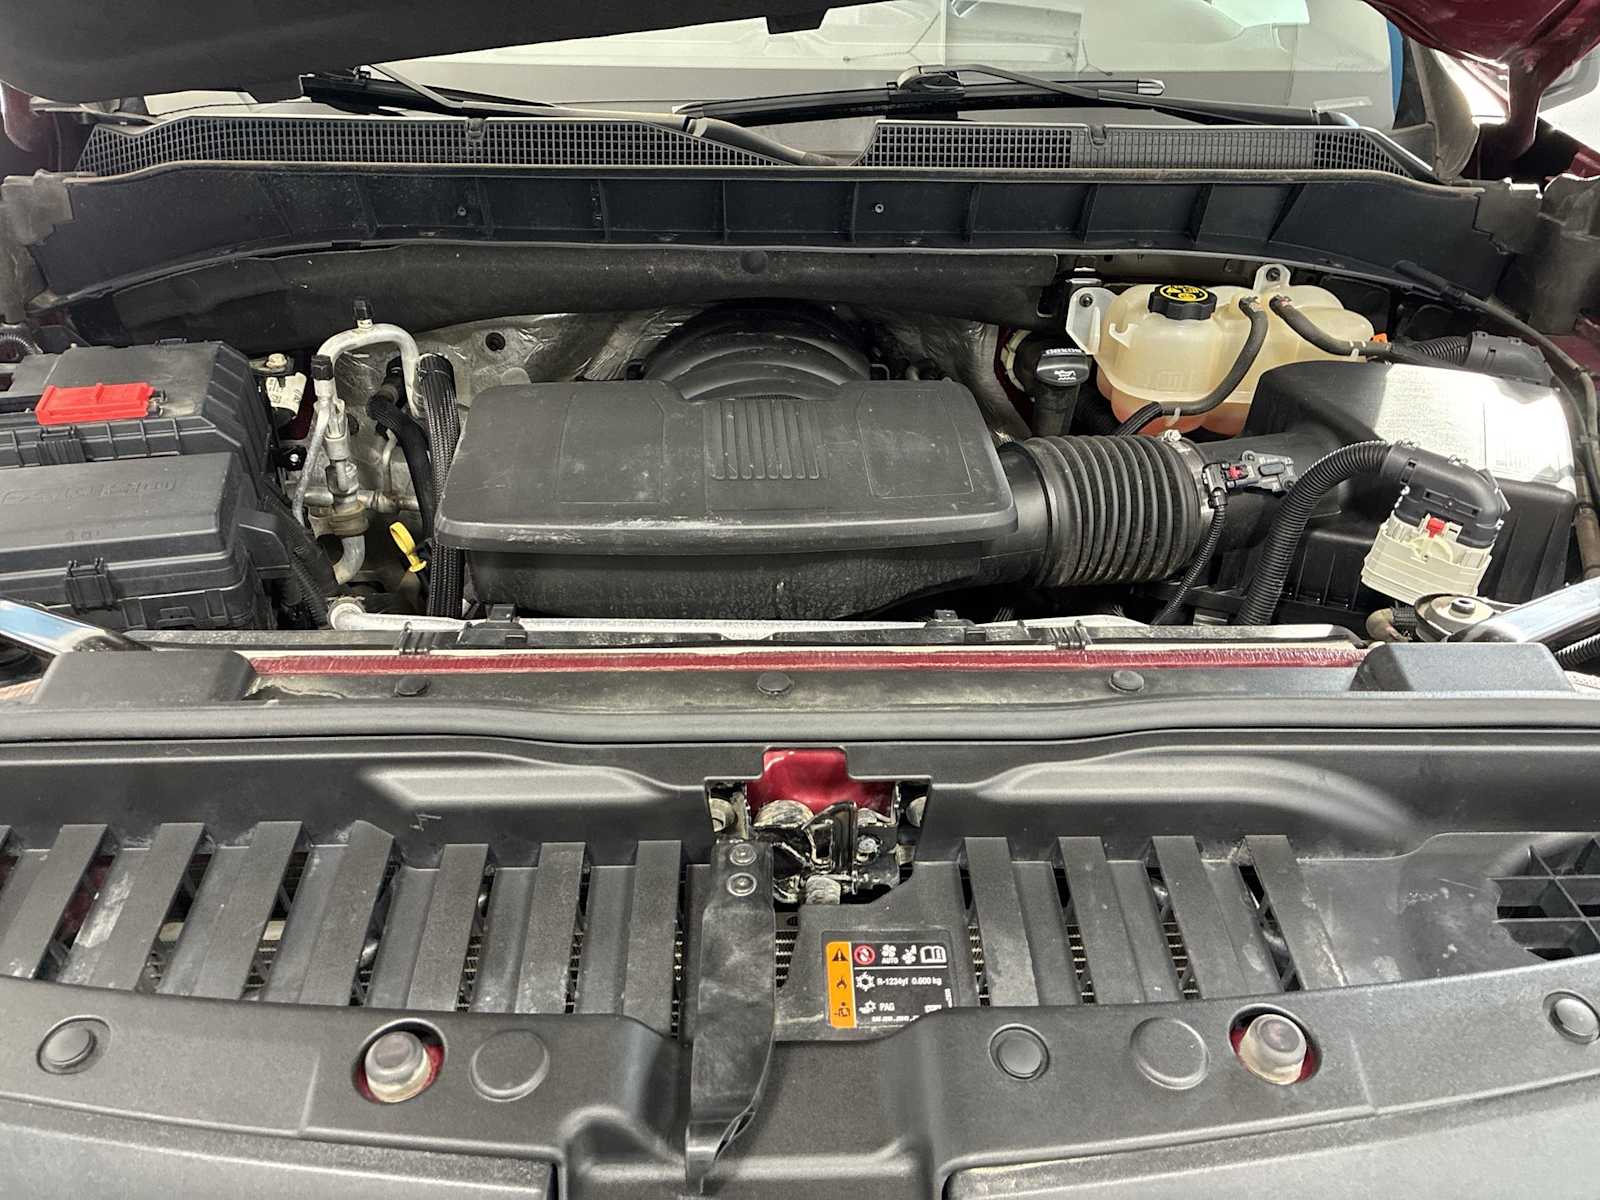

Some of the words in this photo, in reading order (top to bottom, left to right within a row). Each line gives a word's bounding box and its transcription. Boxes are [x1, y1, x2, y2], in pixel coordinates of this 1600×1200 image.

[876, 977, 909, 987] R-1234yf
[932, 977, 943, 986] kg
[879, 1002, 895, 1011] PAG
